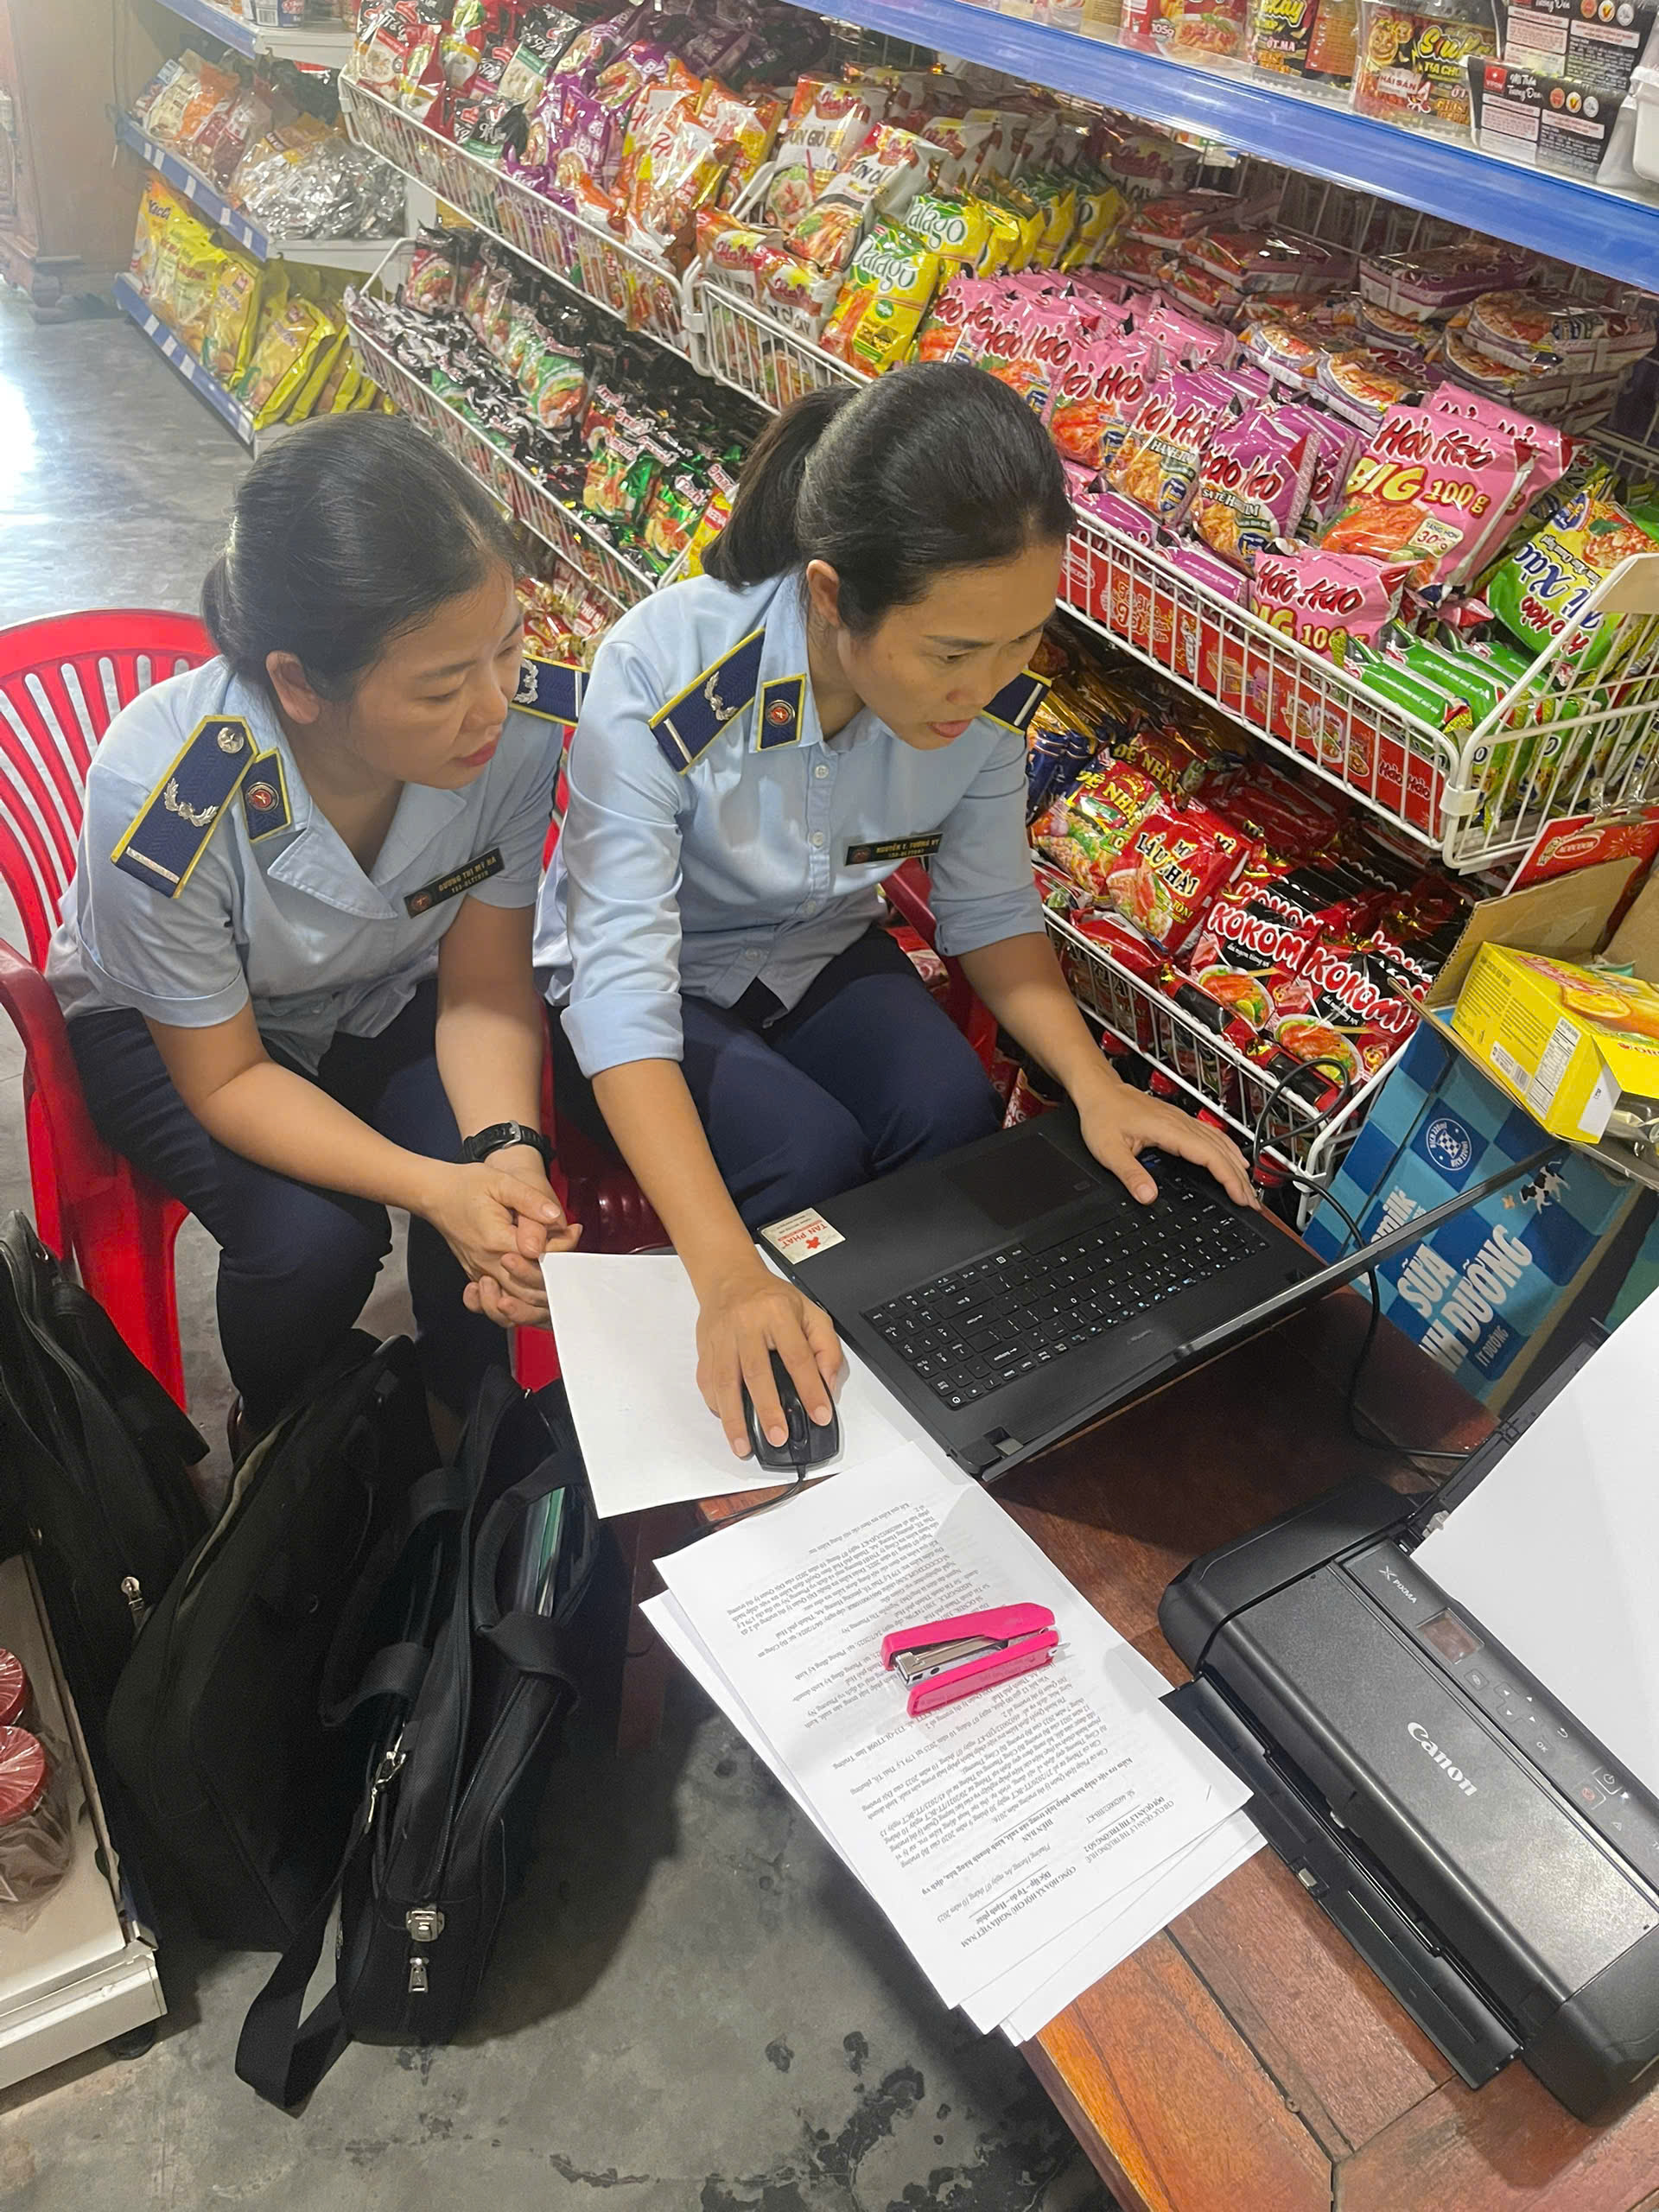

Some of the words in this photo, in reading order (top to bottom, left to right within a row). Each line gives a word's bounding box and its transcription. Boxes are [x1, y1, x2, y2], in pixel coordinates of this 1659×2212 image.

[907, 202, 966, 249] arago
[1344, 456, 1427, 504] BIG
[1207, 901, 1312, 972] KOKOM
[1301, 945, 1412, 1034] KOKOMI
[1396, 1243, 1458, 1319] SỮA
[1440, 1223, 1534, 1344] DƯỠNG
[1418, 1318, 1469, 1376] NH
[1392, 1577, 1418, 1605] PIXMA
[1407, 1721, 1478, 1797] Canon
[1535, 1740, 1549, 1753] OK
